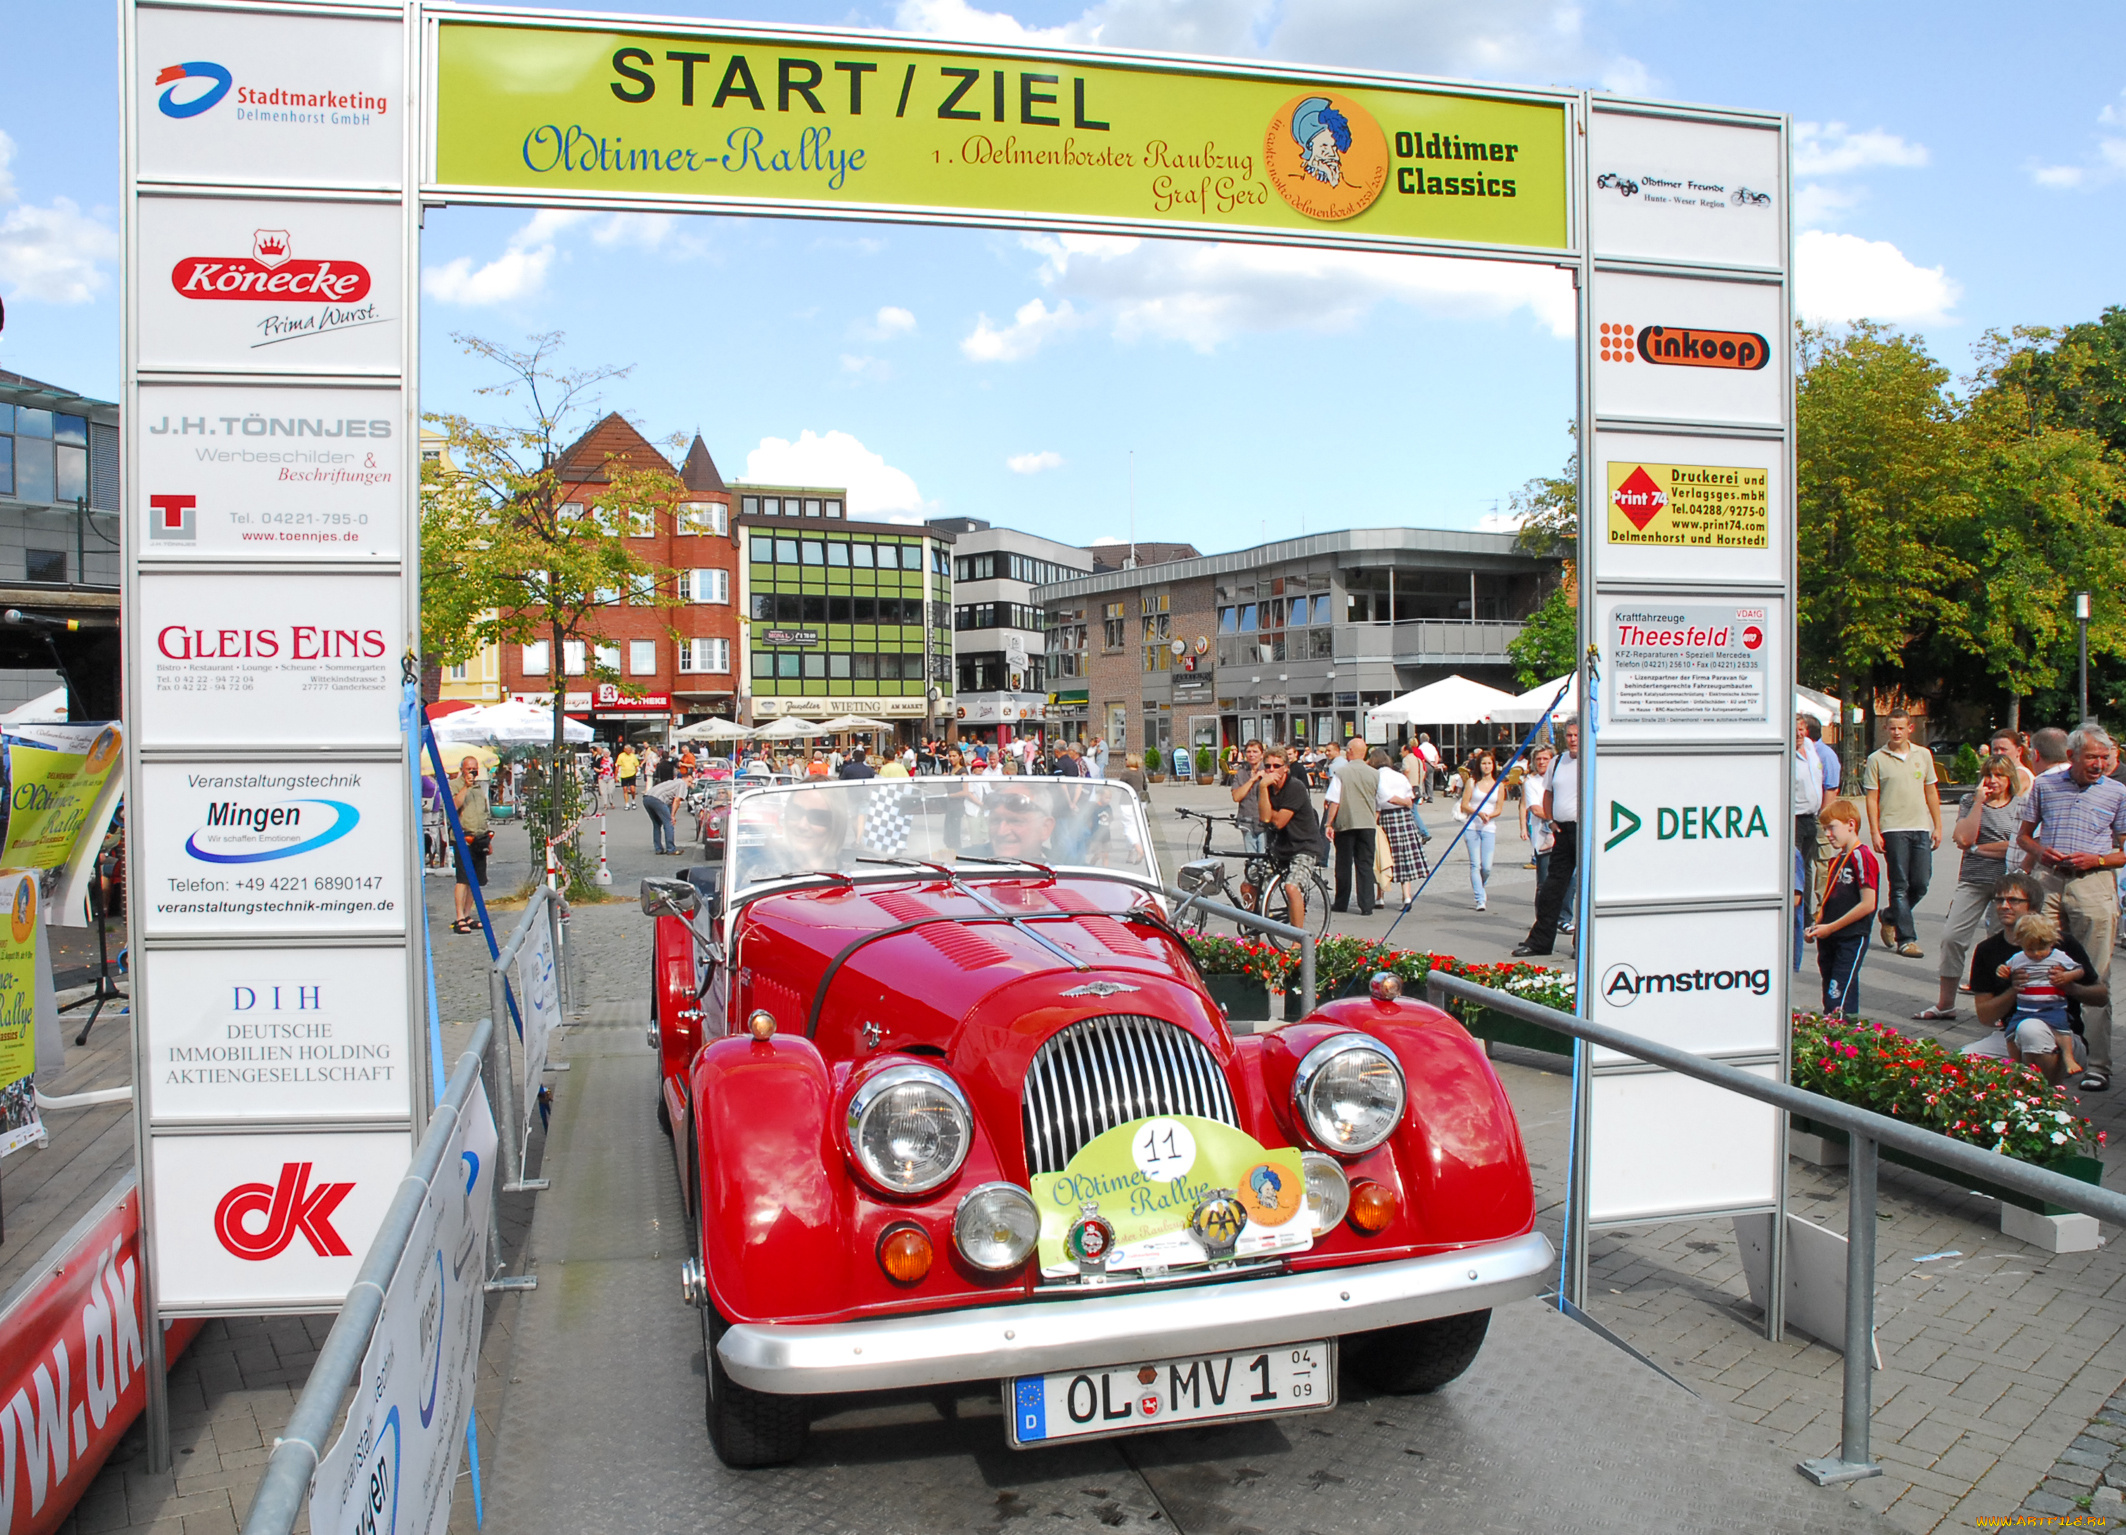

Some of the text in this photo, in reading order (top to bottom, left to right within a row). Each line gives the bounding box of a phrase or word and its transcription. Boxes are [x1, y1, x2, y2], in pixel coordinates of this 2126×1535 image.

[610, 47, 877, 115] START
[937, 66, 1111, 131] ZIEL
[237, 87, 387, 114] Stadtmarketing
[237, 108, 370, 125] Delmenhorst GmbH
[1395, 130, 1519, 163] Oldtimer
[522, 124, 867, 191] Oldtimer-Rallye
[961, 136, 1137, 168] Delmenhorster
[1144, 140, 1255, 181] Raubzug
[1397, 167, 1517, 198] Classics
[1641, 176, 1724, 192] Oldtimer Freunde
[1152, 179, 1268, 215] Graf Gerd
[1644, 194, 1725, 209] Hunte Weser Region
[182, 262, 360, 301] Könecke
[257, 303, 380, 337] Prima Wurst.
[1652, 325, 1756, 367] inkoop
[195, 448, 354, 463] Werbeschilder
[278, 467, 392, 485] Beschriftungen
[1671, 468, 1765, 485] Druckerei und
[1612, 489, 1669, 506] Print 74
[230, 512, 368, 525] Tel. 04221-795-0
[1671, 519, 1765, 532] www.print74.com
[242, 530, 359, 543] www.toennjes.de
[1611, 530, 1765, 545] Delmenhorst und Horstedt
[1616, 612, 1685, 624] Kraftfahrzeuge
[157, 625, 386, 660] GLEIS EINS
[1618, 625, 1728, 647] Theesfeld
[1615, 651, 1679, 659] KFZ-Reparaturen
[1685, 651, 1714, 659] Speziell
[242, 664, 272, 673] Lounge
[325, 664, 386, 673] Sommergarten
[310, 675, 378, 683] Wittekindstrasse
[332, 683, 386, 691] Ganderkesee
[830, 702, 881, 712] WIETING
[188, 774, 361, 791] Veranstaltungstechnik
[207, 802, 300, 832] Mingen
[1657, 804, 1769, 840] DEKRA
[207, 834, 301, 843] Wir schaffen Emotionen
[168, 876, 383, 892] Telefon: +49 4221 6890147
[157, 899, 394, 915] veranstaltungstechnik-mingen.de
[1606, 968, 1770, 996] Armstrong
[227, 1023, 333, 1039] DEUTSCHE
[169, 1044, 391, 1062] IMMOBILIEN HOLDING
[166, 1066, 395, 1084] AKTIENGESELLSCHAFT
[1144, 1127, 1182, 1162] 11
[214, 1162, 357, 1261] dk
[1292, 1350, 1311, 1364] 04
[1067, 1354, 1277, 1424] OL MV 1
[1292, 1383, 1312, 1398] 09
[1025, 1415, 1037, 1430] D
